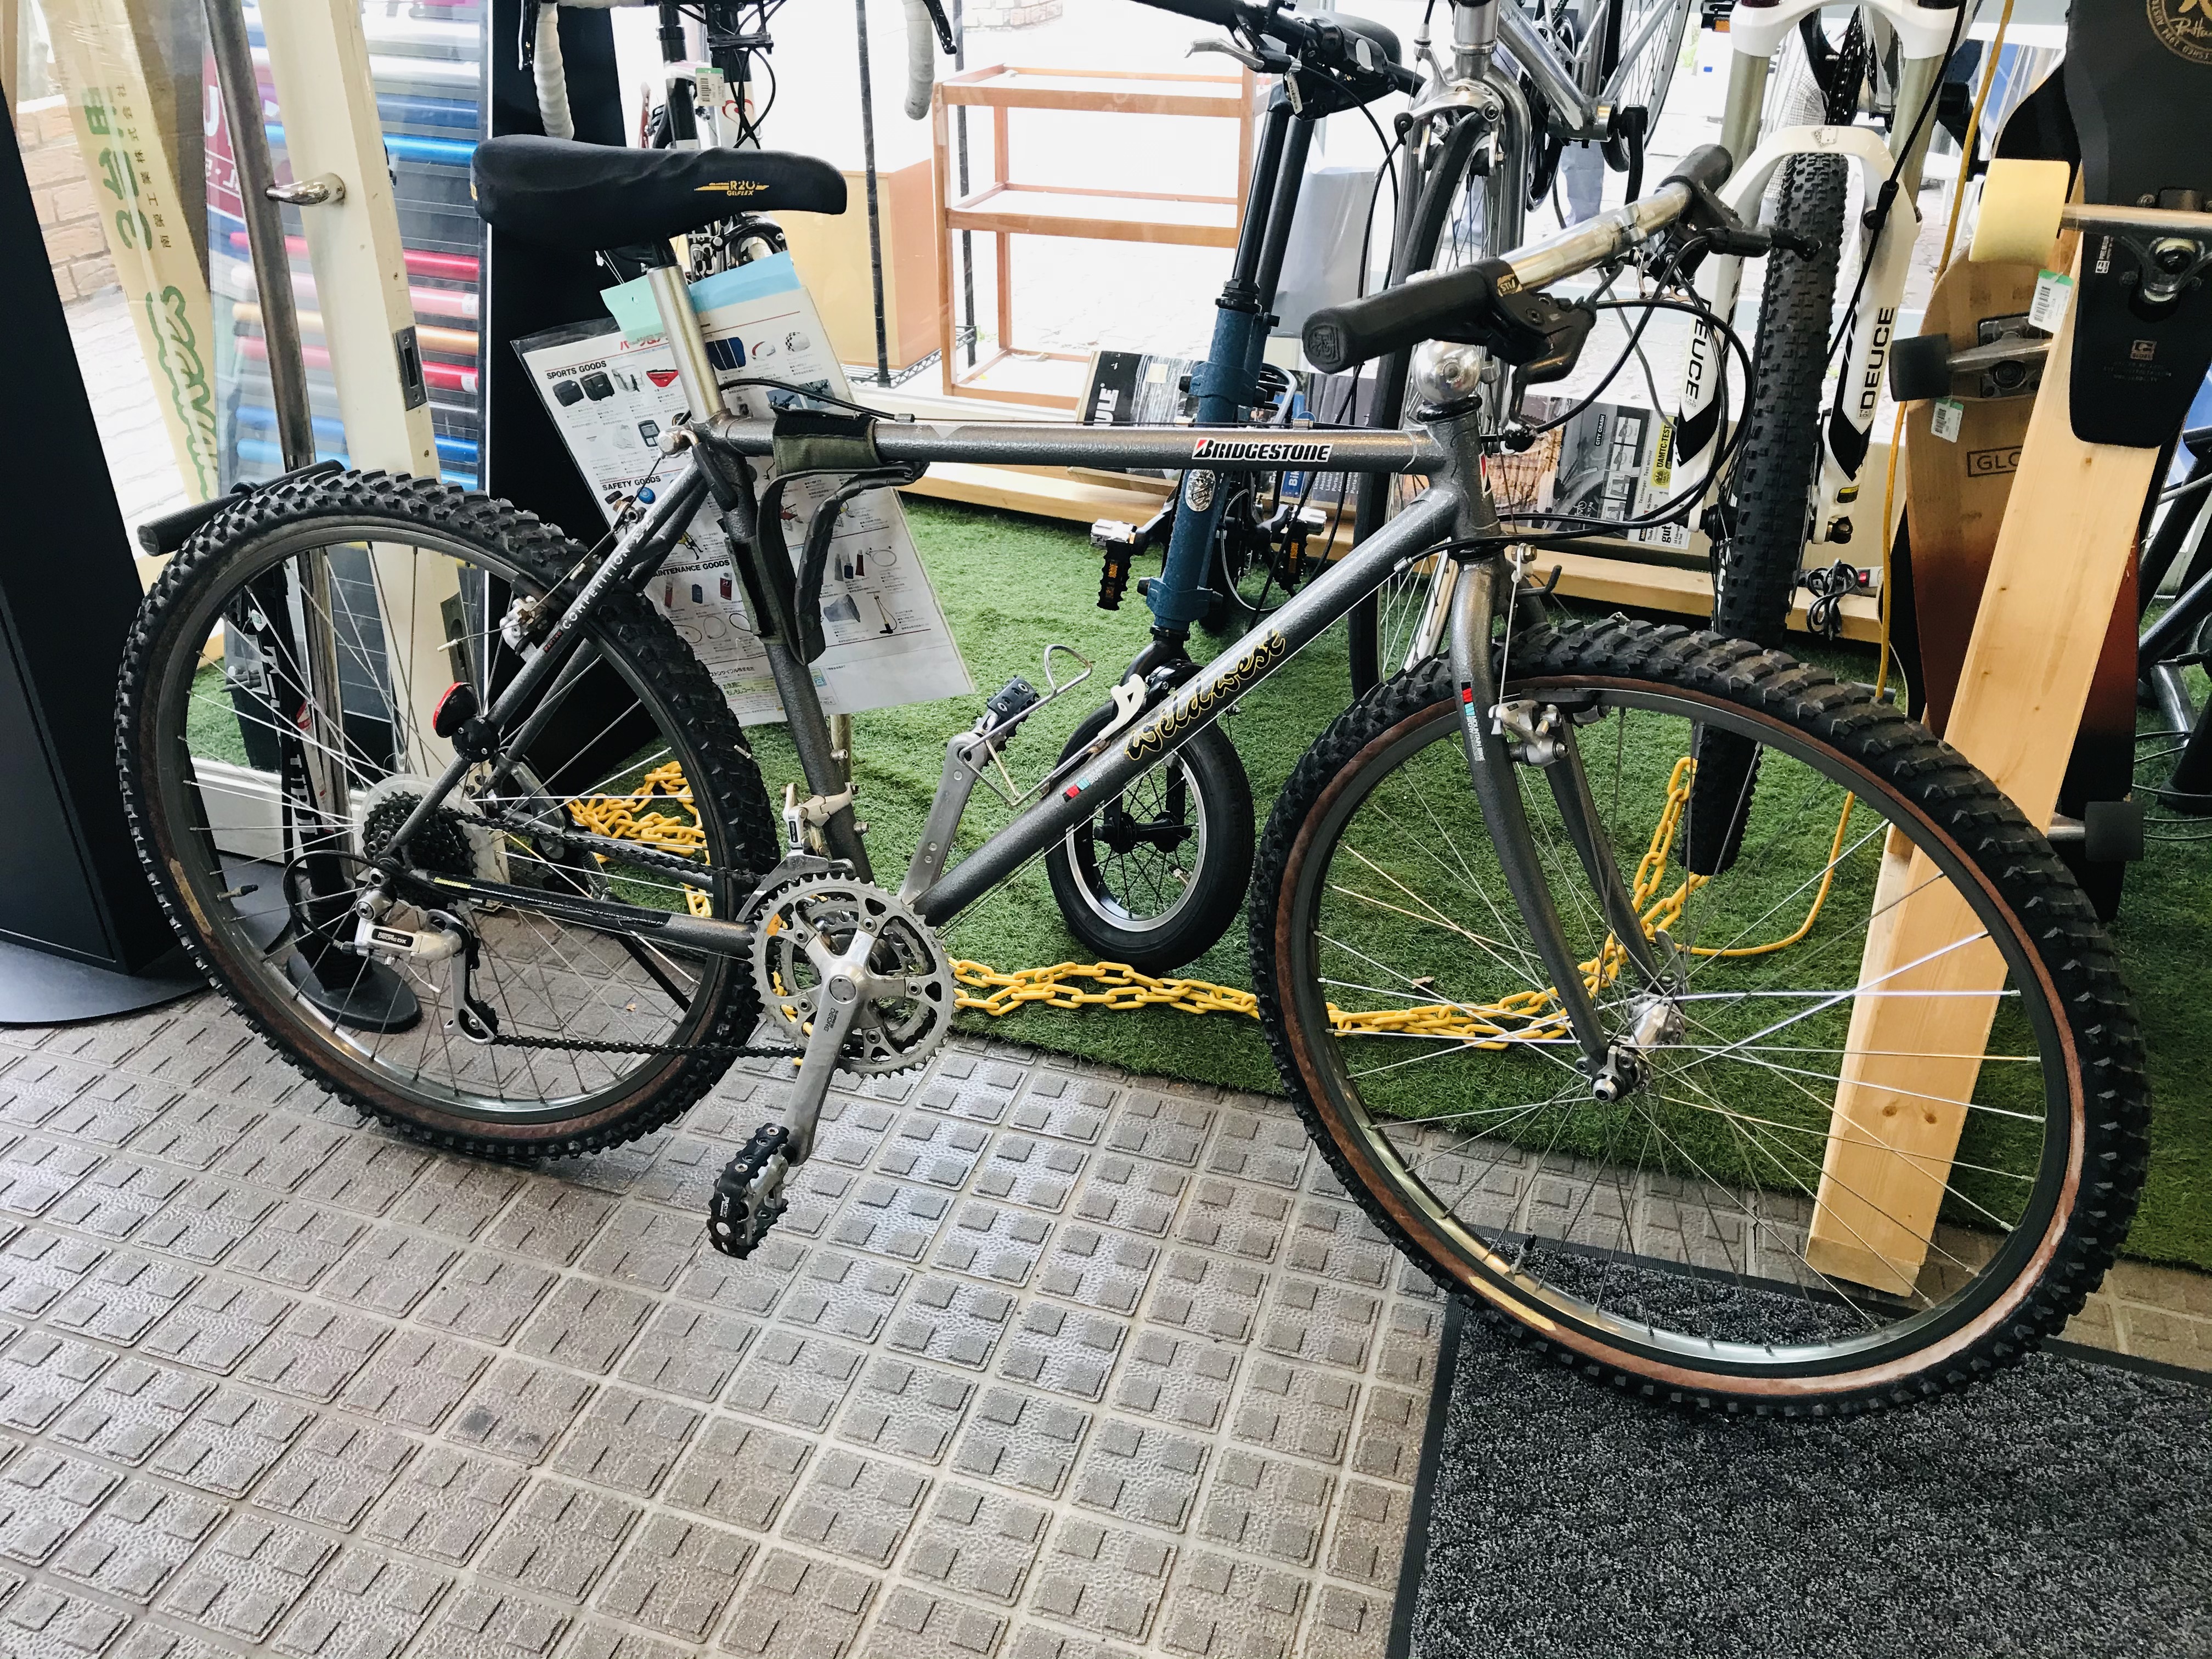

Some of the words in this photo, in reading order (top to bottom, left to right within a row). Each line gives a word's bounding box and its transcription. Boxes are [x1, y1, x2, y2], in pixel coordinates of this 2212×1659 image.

[1860, 307, 1895, 409] DEUCE
[546, 367, 577, 380] SPORTS
[579, 360, 607, 373] GOODS
[1193, 439, 1331, 461] BRIDGESTONE
[602, 480, 631, 491] SAFETY
[634, 476, 661, 486] GOODS
[1661, 525, 1672, 544] gut
[703, 559, 730, 569] GOODS
[562, 546, 631, 629] COMPETITION
[1471, 715, 1482, 747] MOUNTAIN
[1477, 747, 1485, 761] BIKE
[823, 1007, 836, 1032] DEORE
